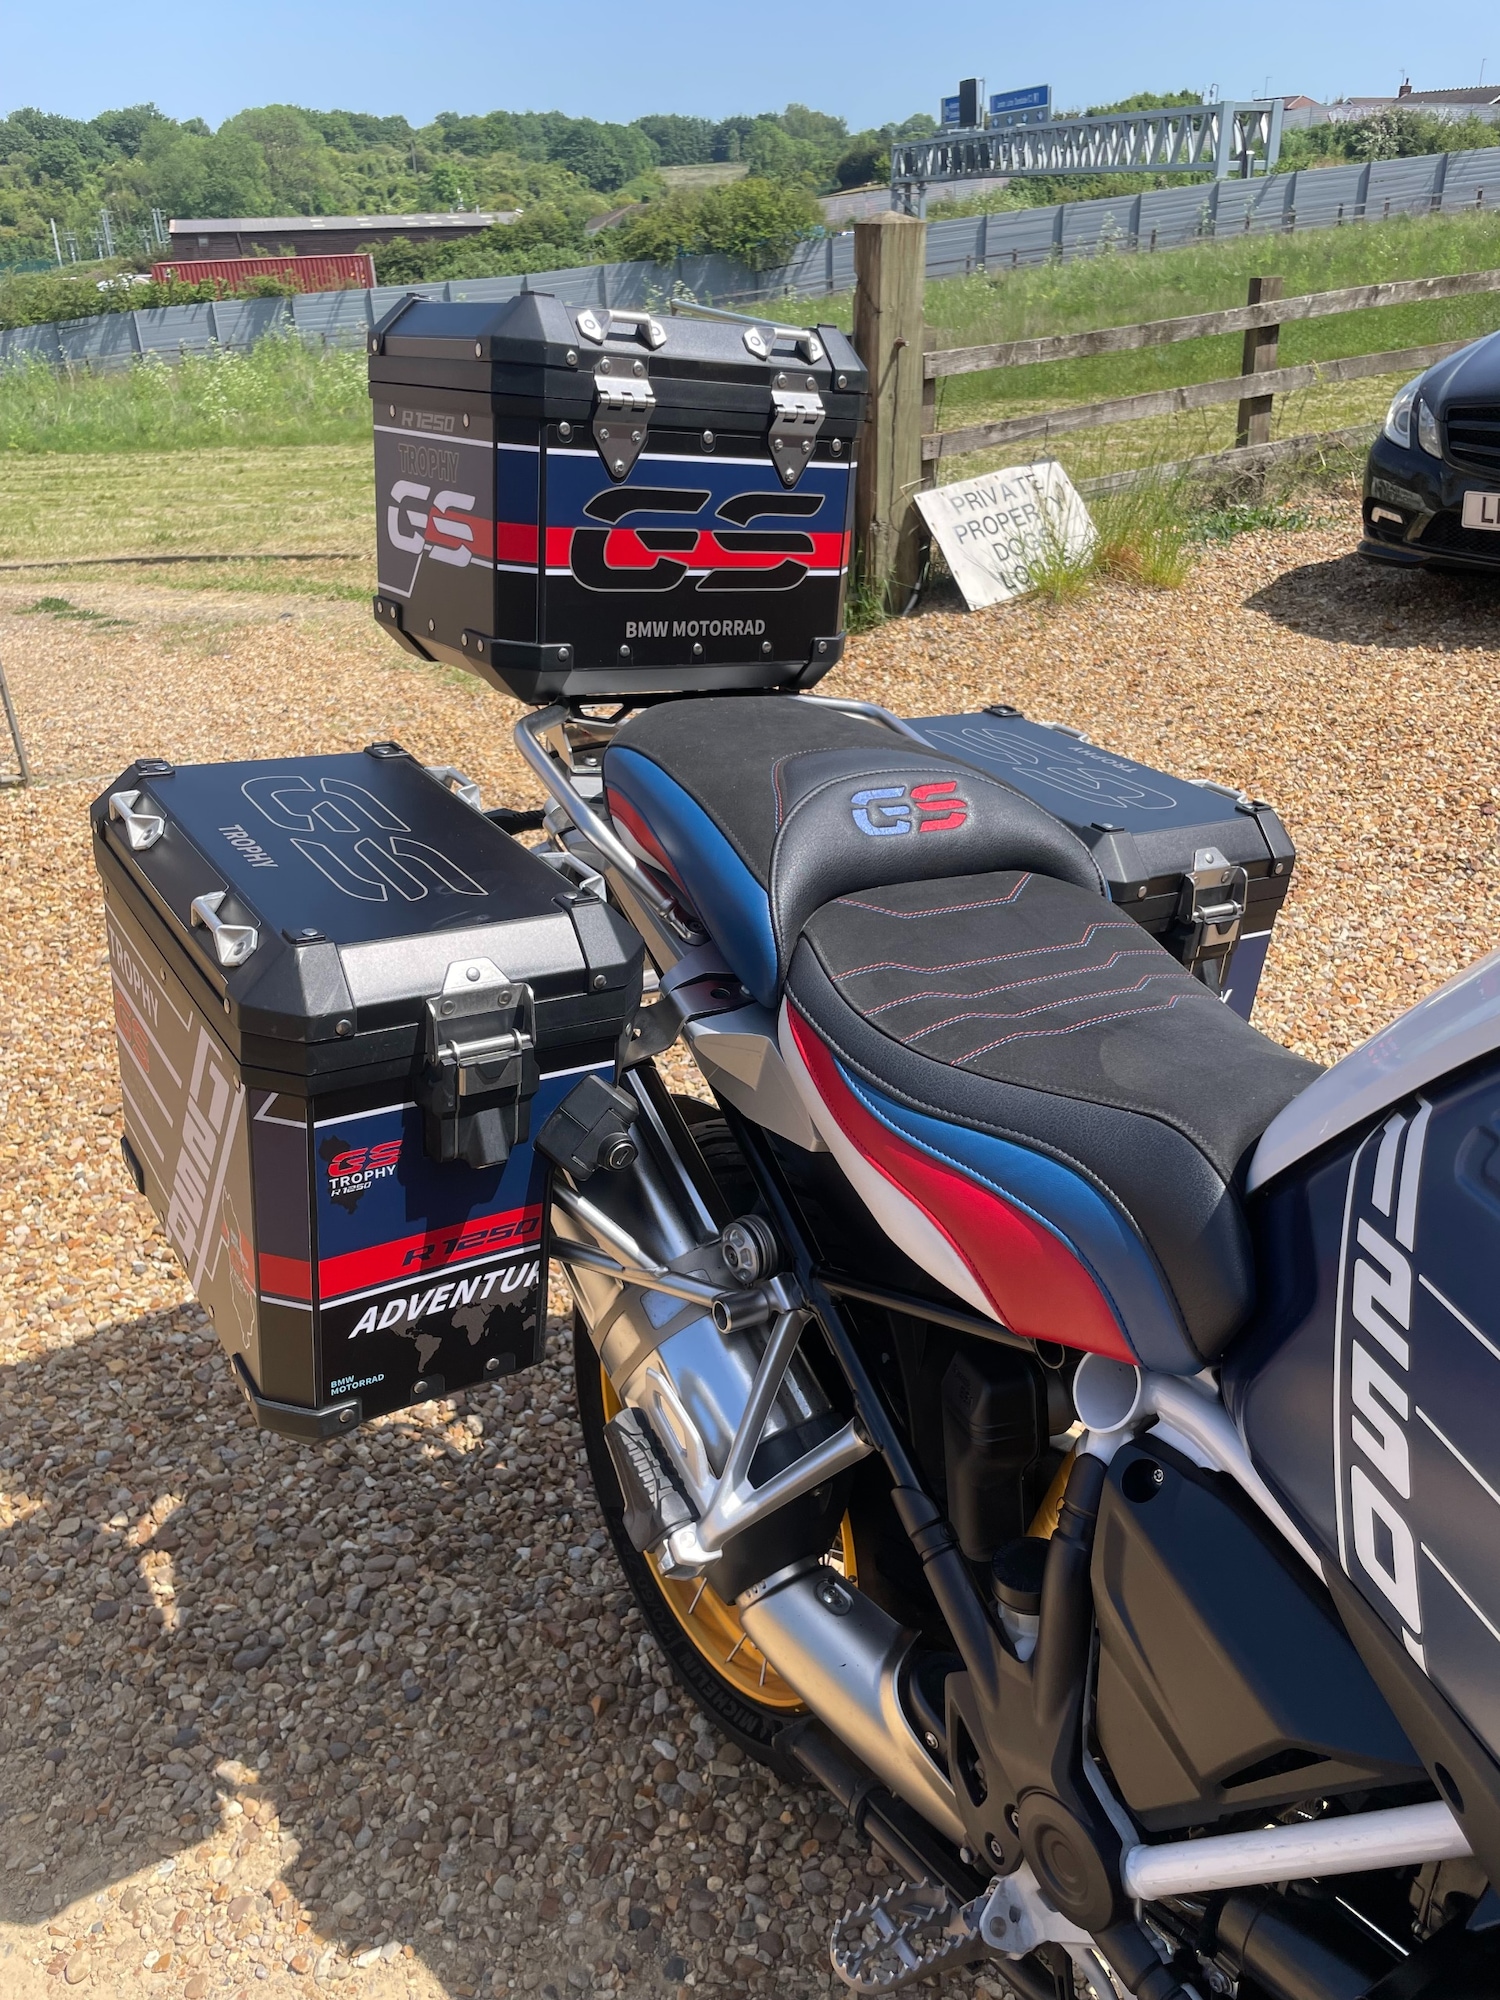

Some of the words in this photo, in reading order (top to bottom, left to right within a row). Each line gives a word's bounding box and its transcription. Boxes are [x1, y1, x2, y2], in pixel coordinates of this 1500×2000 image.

[398, 443, 459, 483] TROPHY
[950, 473, 1044, 516] PRIVATE
[952, 488, 1065, 544] PROPERY
[1481, 496, 1500, 524] L
[388, 480, 476, 568] GS
[569, 486, 826, 592] GS
[625, 620, 669, 638] BMW
[672, 619, 766, 638] MOTORRAD
[1067, 746, 1138, 773] TROPHY
[850, 780, 968, 837] GS
[218, 823, 280, 870] TROPHY
[108, 922, 159, 1028] TROPHY
[115, 988, 150, 1074] GS
[328, 1139, 403, 1177] GS
[329, 1165, 397, 1189] TROPHY
[330, 1373, 385, 1396] MOTORRAD
[331, 1375, 355, 1388] BMW
[679, 1648, 765, 1735] MICHELIN
